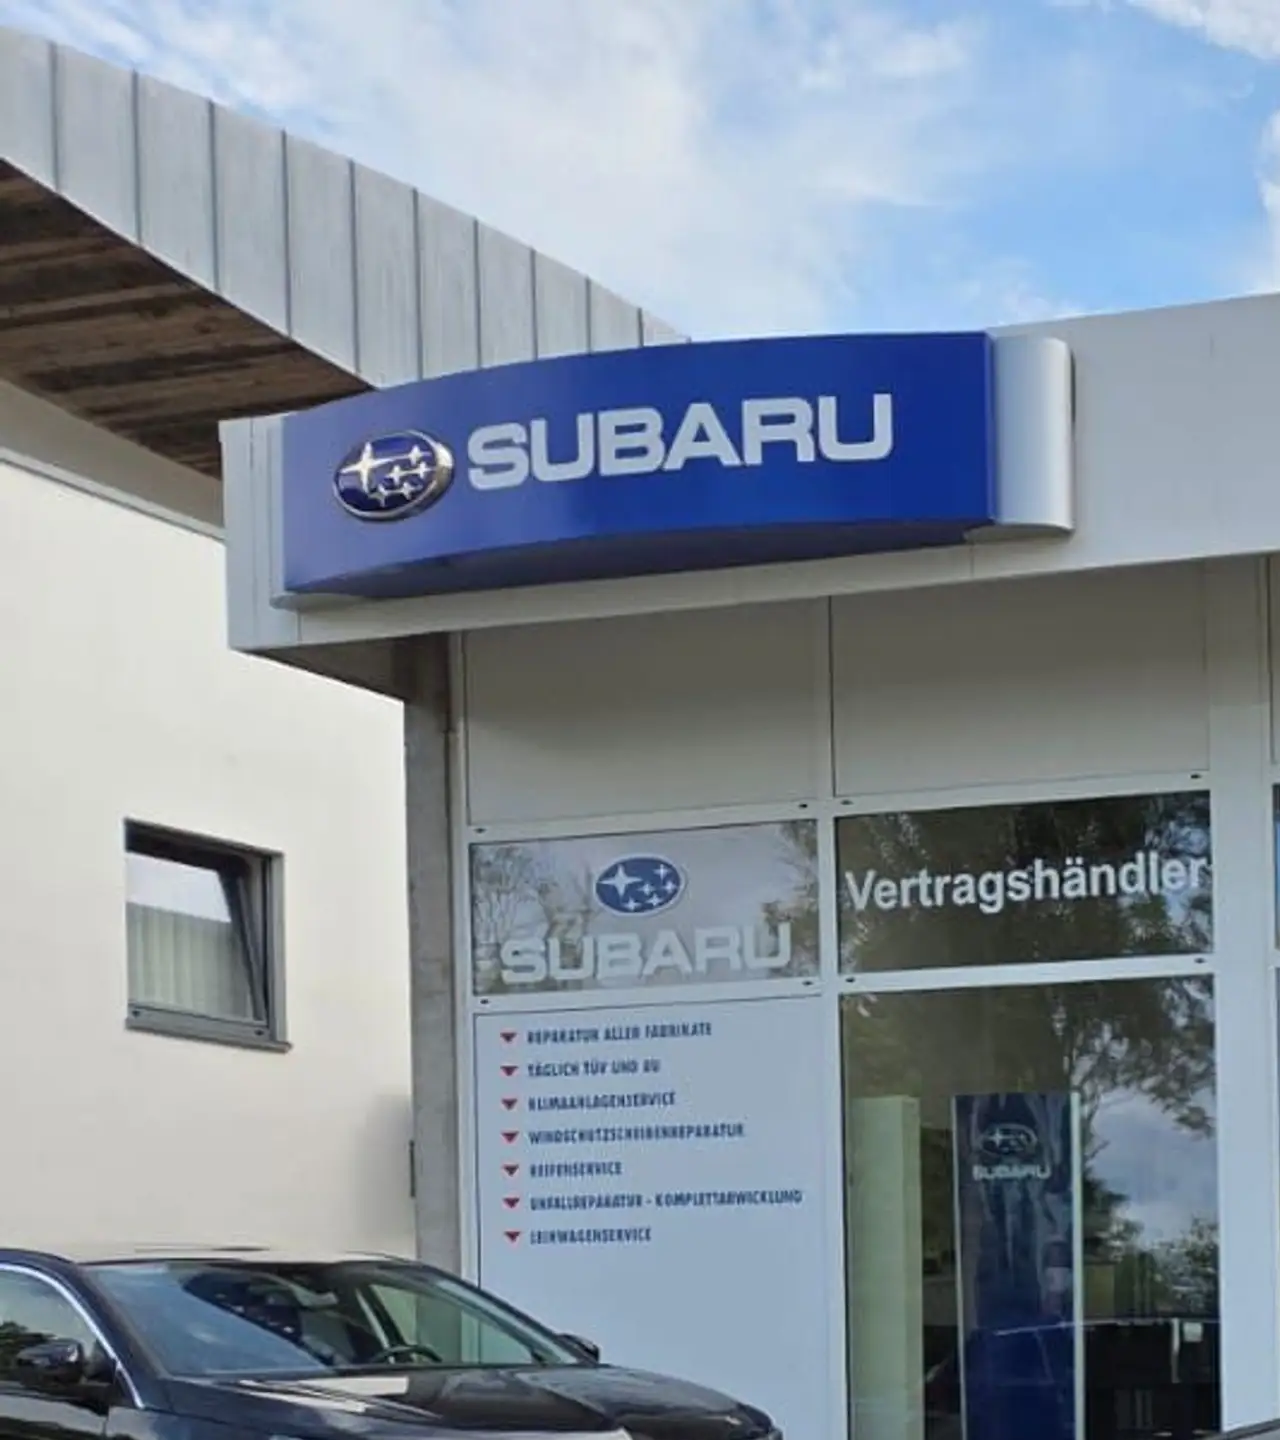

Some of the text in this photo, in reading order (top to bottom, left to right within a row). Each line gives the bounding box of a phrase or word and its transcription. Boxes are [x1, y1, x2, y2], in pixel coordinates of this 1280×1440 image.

[467, 393, 893, 491] SUBARU
[844, 849, 1208, 914] Vertragshändler
[500, 921, 792, 985] SUBARU
[527, 1026, 599, 1044] REPARATUR
